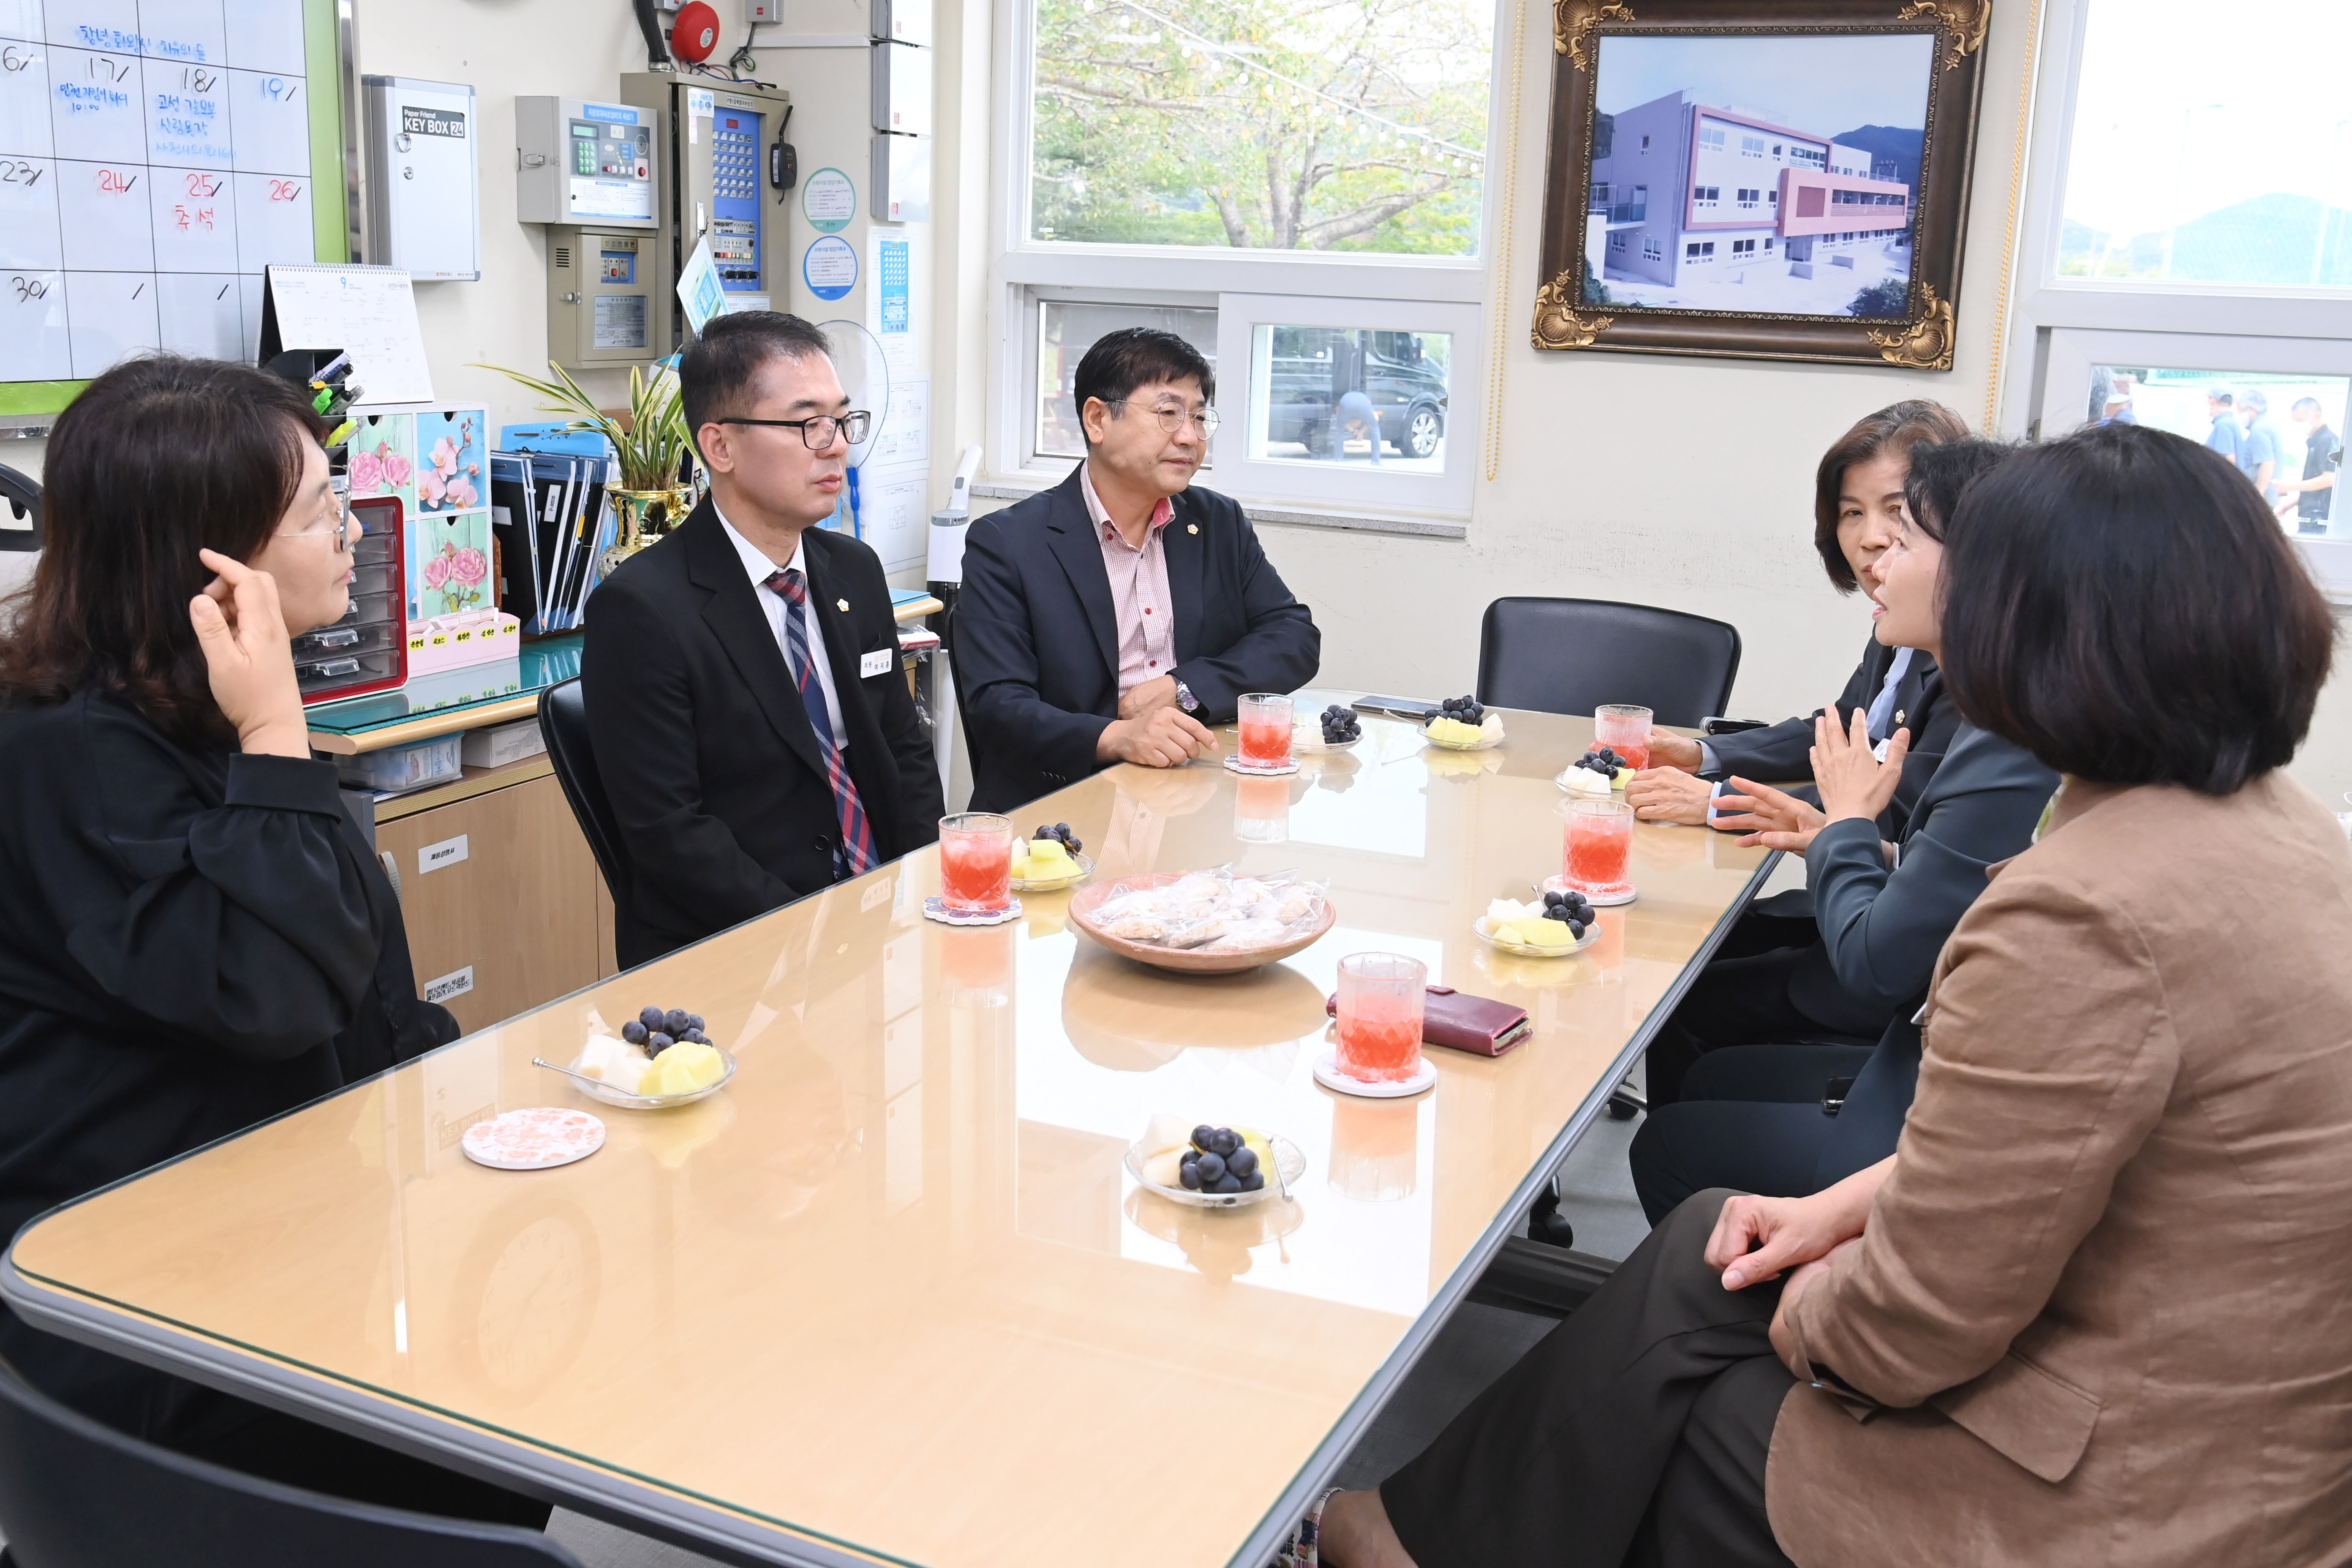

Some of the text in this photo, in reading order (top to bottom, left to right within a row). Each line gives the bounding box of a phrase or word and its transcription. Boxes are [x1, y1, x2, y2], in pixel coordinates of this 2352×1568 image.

[72, 103, 99, 112] 10:00
[404, 109, 436, 119] Paper Friend
[405, 117, 463, 135] KEY BOX 24
[175, 205, 213, 230] 추석
[340, 277, 346, 289] 9
[320, 363, 345, 381] MARKER
